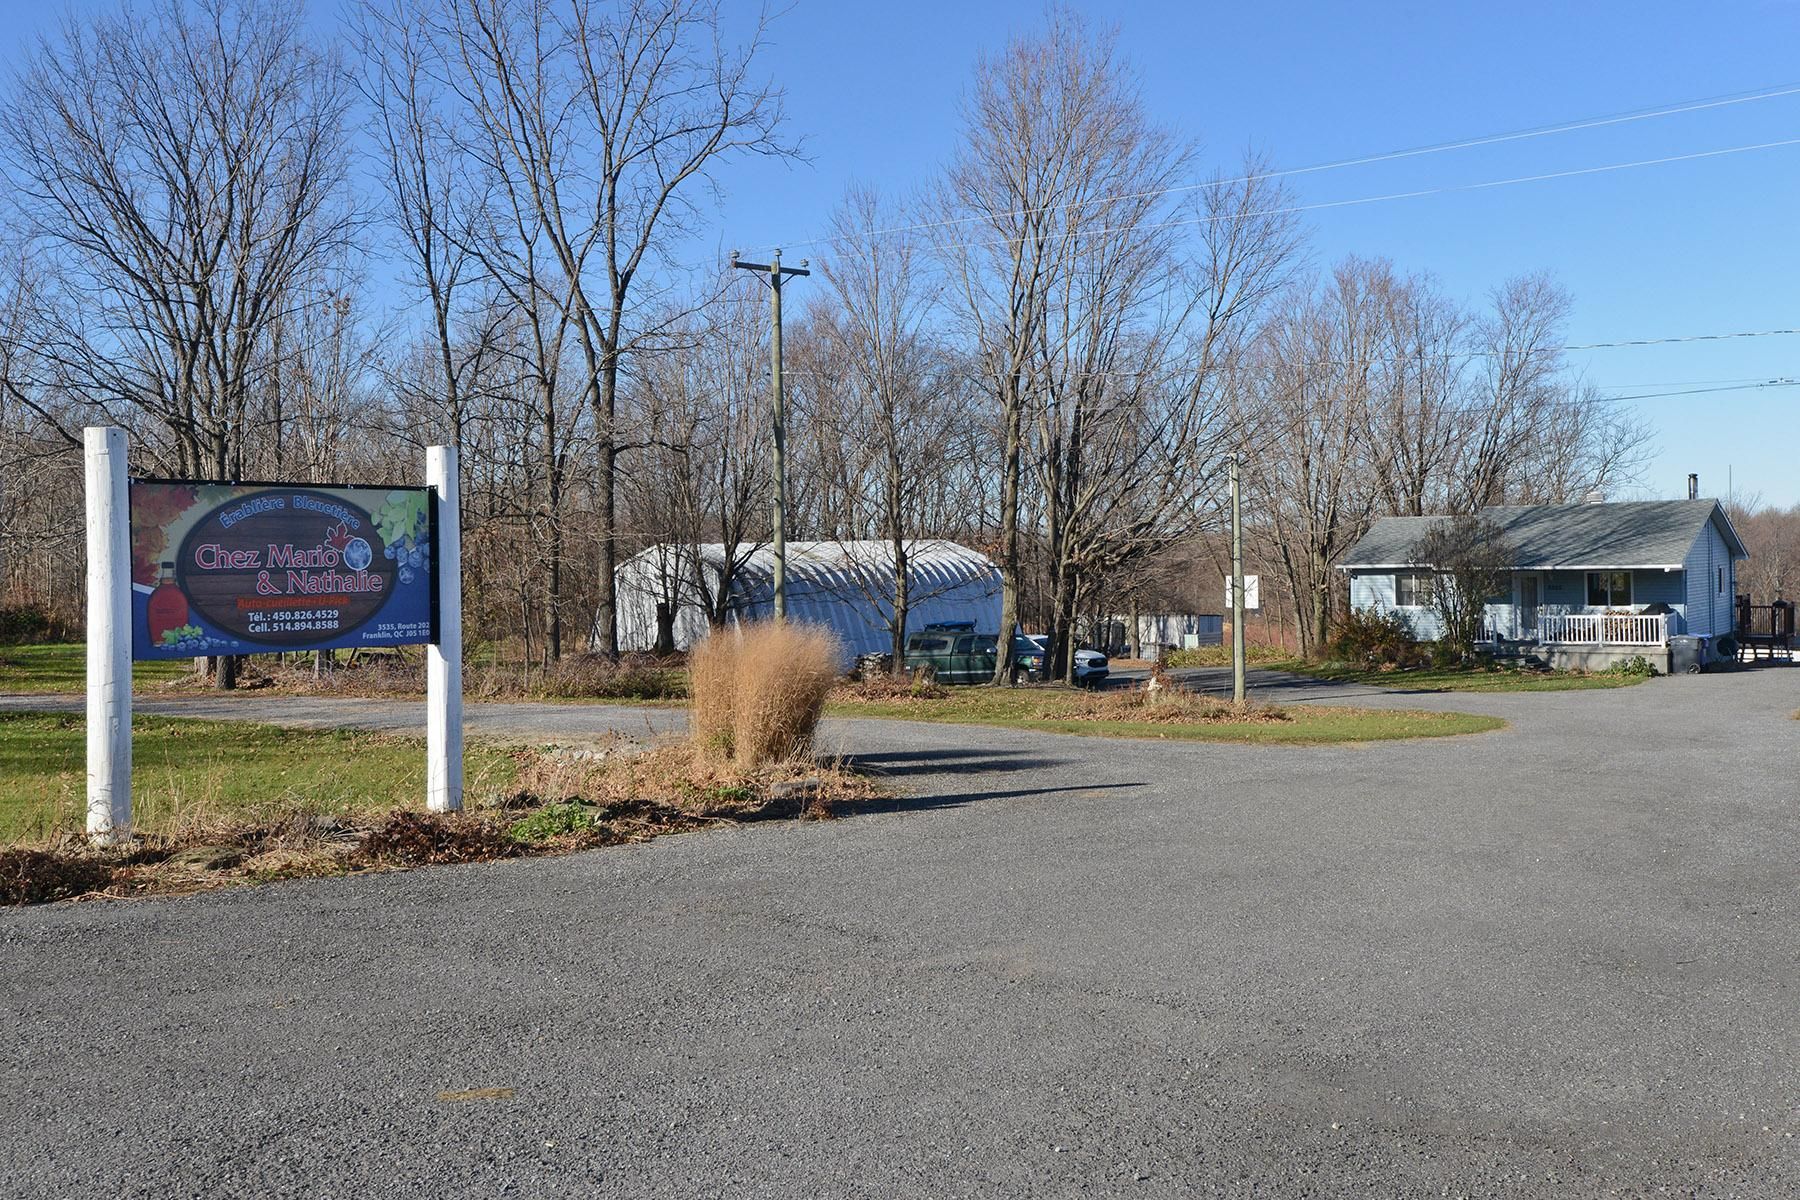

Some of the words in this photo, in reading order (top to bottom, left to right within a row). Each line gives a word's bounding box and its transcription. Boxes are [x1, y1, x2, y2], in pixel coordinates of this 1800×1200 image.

[218, 496, 285, 529] Érablière
[292, 495, 360, 529] Bleuetière
[195, 544, 261, 569] Chez
[266, 544, 339, 569] Mario
[256, 570, 282, 595] &
[286, 570, 383, 594] Nathalie
[272, 609, 339, 621] 450.826.4529
[248, 622, 271, 633] Cell.
[272, 620, 339, 632] 514.894.8588
[394, 630, 404, 638] QC
